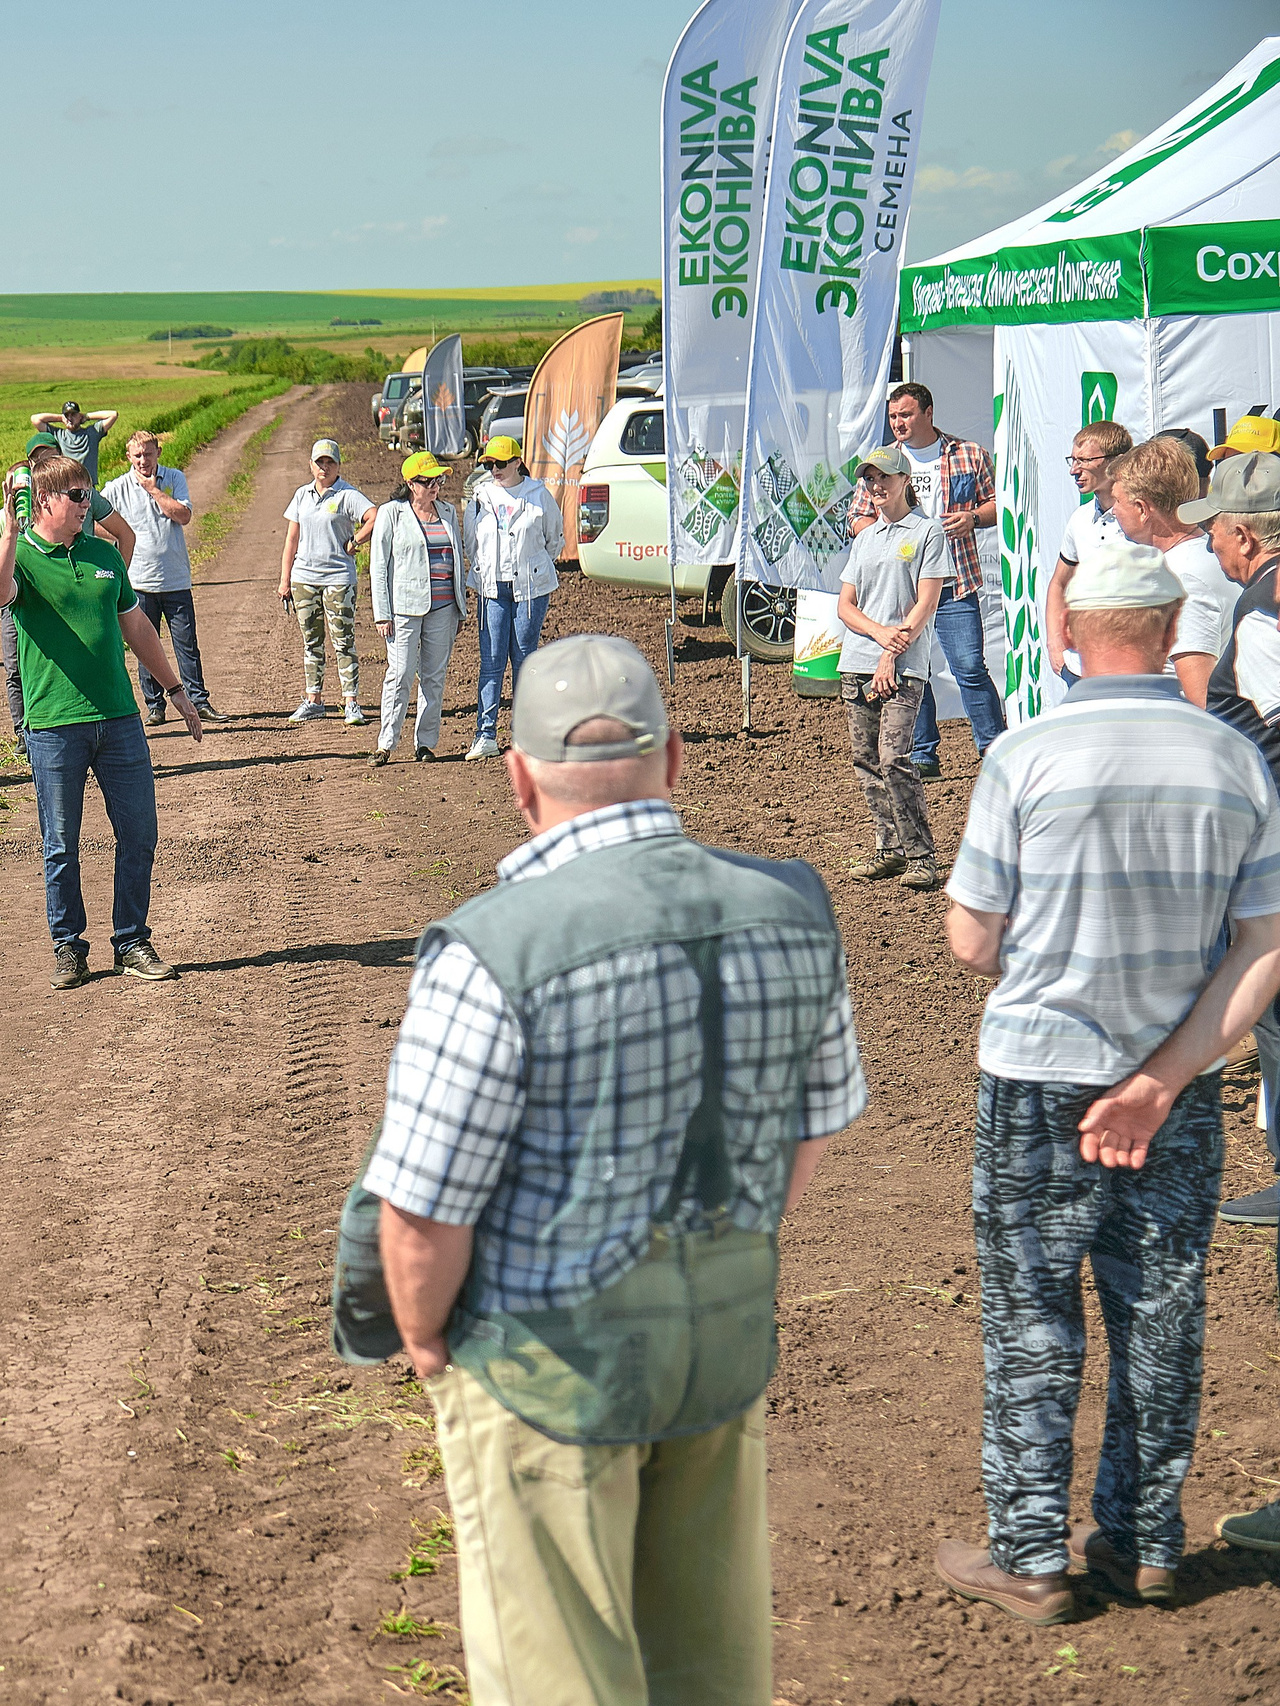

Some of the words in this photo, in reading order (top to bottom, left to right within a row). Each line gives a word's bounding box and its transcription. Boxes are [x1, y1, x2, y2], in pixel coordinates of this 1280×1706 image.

[678, 59, 719, 286] EKONIVA
[711, 75, 759, 320] ЭКОНИВА
[780, 22, 850, 274] EKONIVA
[815, 47, 891, 319] ЭКОНИВА
[874, 109, 913, 253] СЕМЕНА
[983, 261, 1056, 307] Химическая
[1056, 250, 1122, 303] Компания
[1196, 244, 1280, 287] Сох
